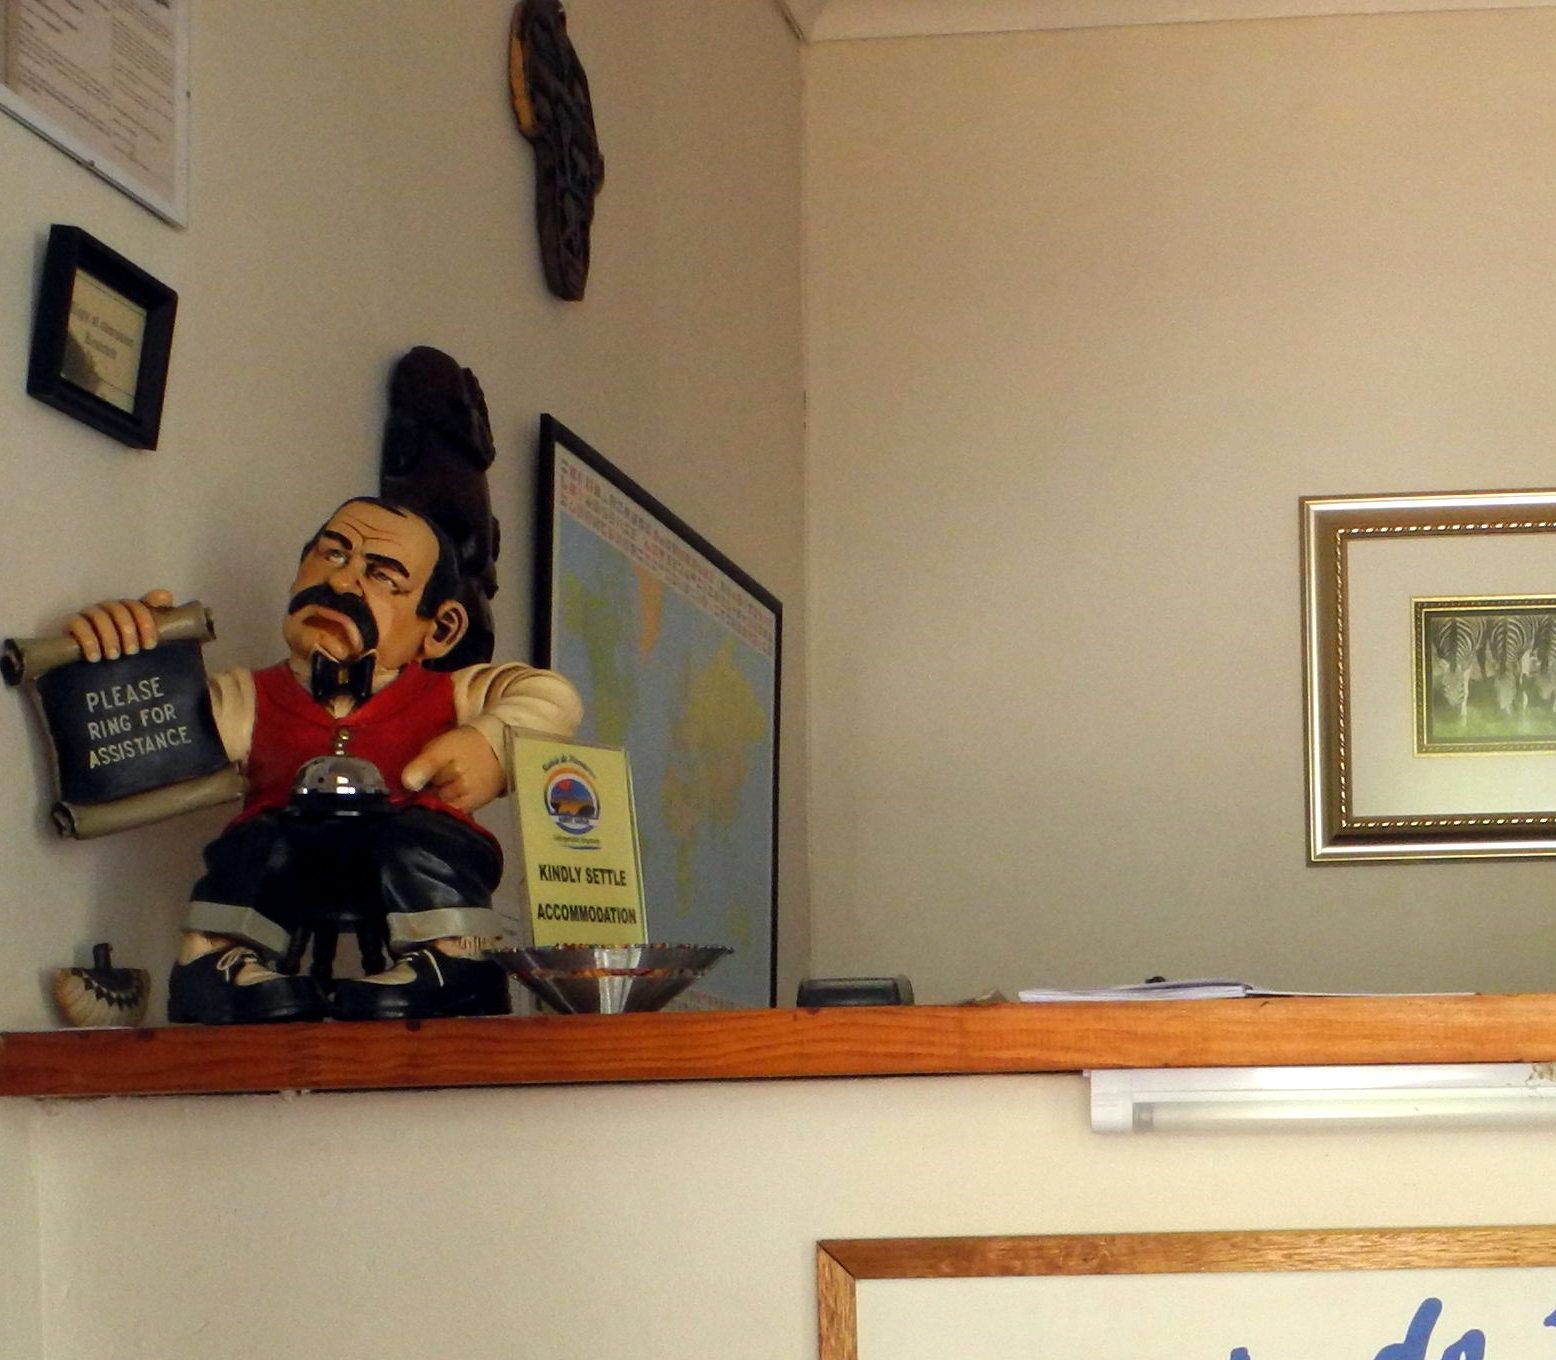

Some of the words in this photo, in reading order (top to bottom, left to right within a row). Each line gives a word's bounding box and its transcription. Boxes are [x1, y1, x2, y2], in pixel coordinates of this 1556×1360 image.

[86, 677, 165, 713] PLEASE
[87, 715, 132, 741] RING
[139, 703, 177, 727] FOR
[88, 726, 192, 769] ASSISTANCE
[538, 863, 582, 884] KINDLY
[586, 867, 627, 887] SETTLE
[537, 903, 637, 925] ACCOMMODATION
